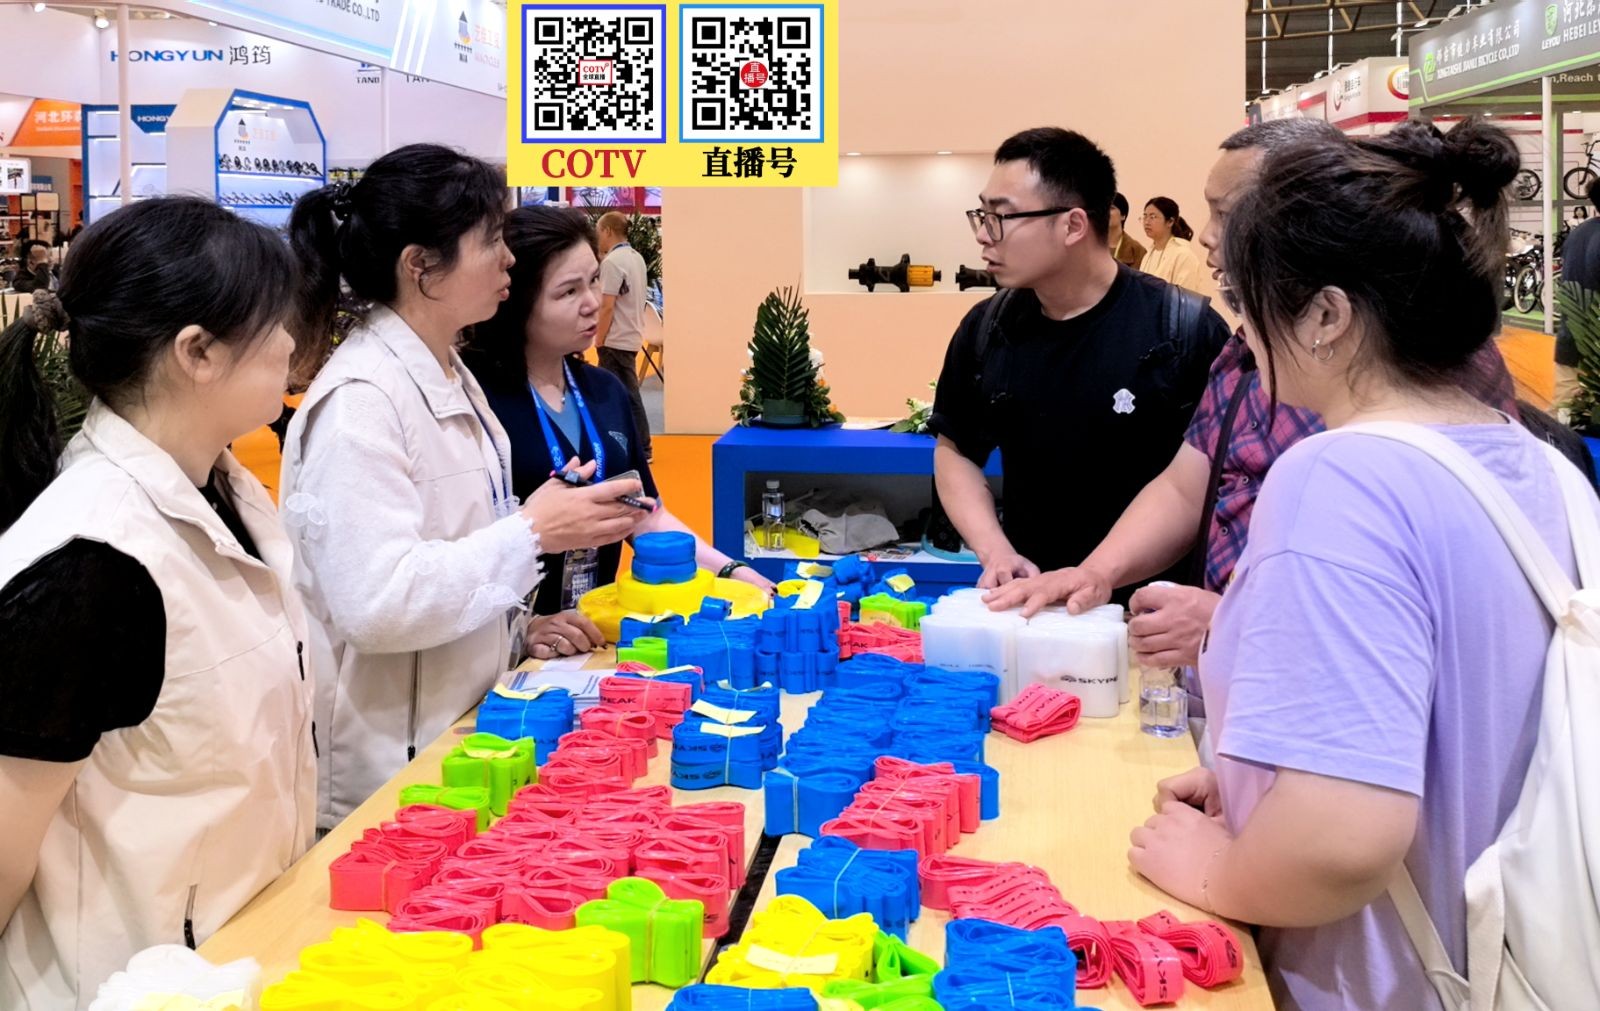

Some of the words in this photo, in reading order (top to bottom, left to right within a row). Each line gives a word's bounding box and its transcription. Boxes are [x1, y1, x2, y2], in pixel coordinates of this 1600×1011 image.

[1563, 23, 1587, 42] HEBEI
[1541, 35, 1561, 50] LEYOU
[110, 50, 223, 62] HONGYUN
[1478, 51, 1498, 67] BICYCLE
